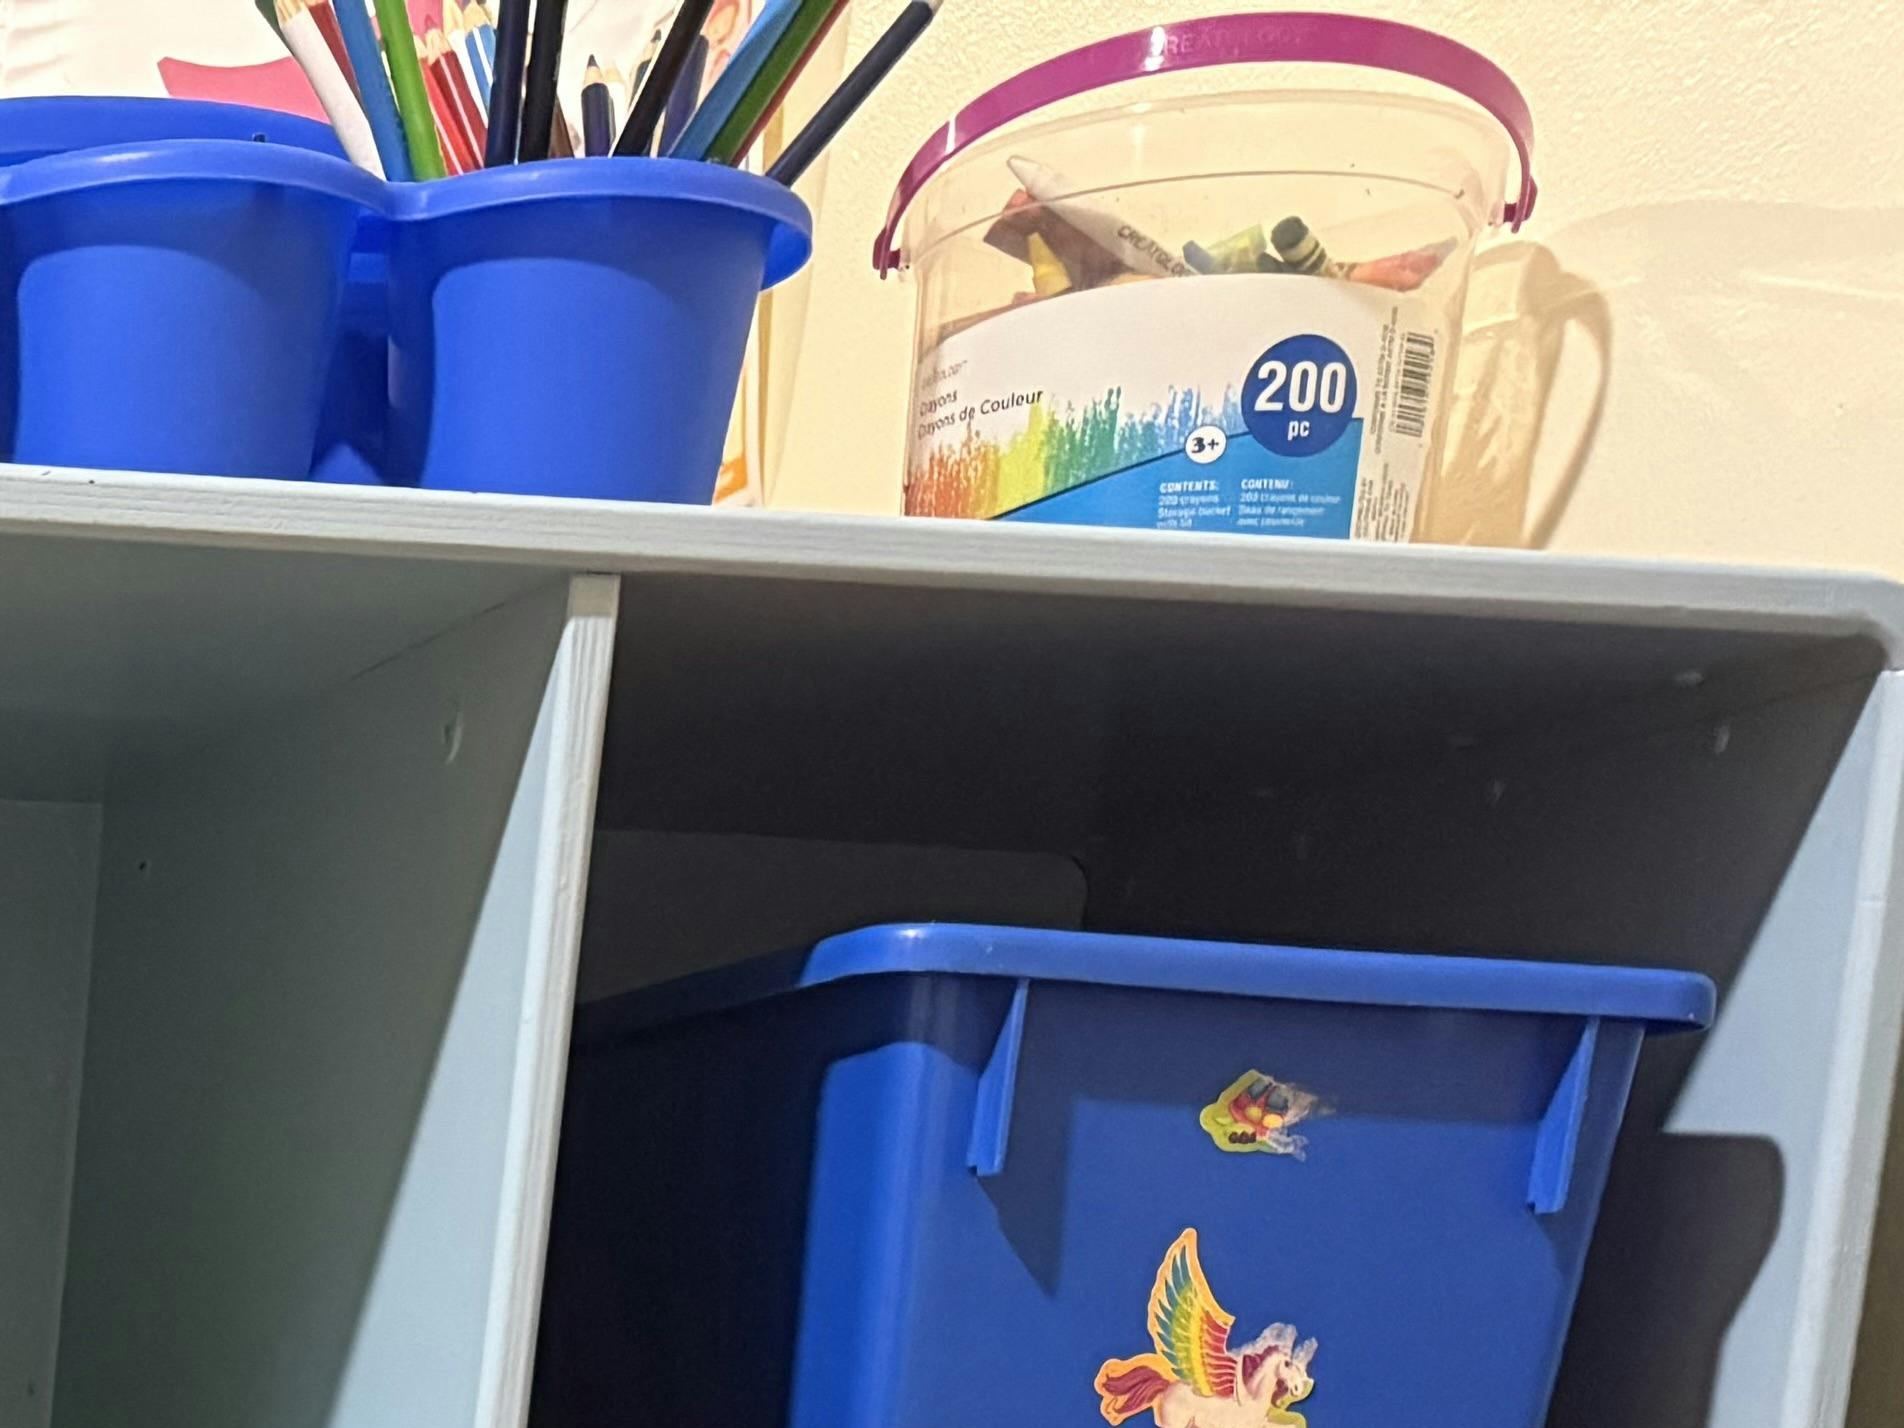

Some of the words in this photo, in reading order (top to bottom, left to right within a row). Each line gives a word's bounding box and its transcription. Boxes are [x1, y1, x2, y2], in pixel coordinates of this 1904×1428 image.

[1254, 360, 1347, 413] 200
[959, 405, 975, 422] de
[980, 390, 1044, 415] Couleur
[1287, 420, 1310, 441] pc
[1191, 436, 1220, 454] 3+
